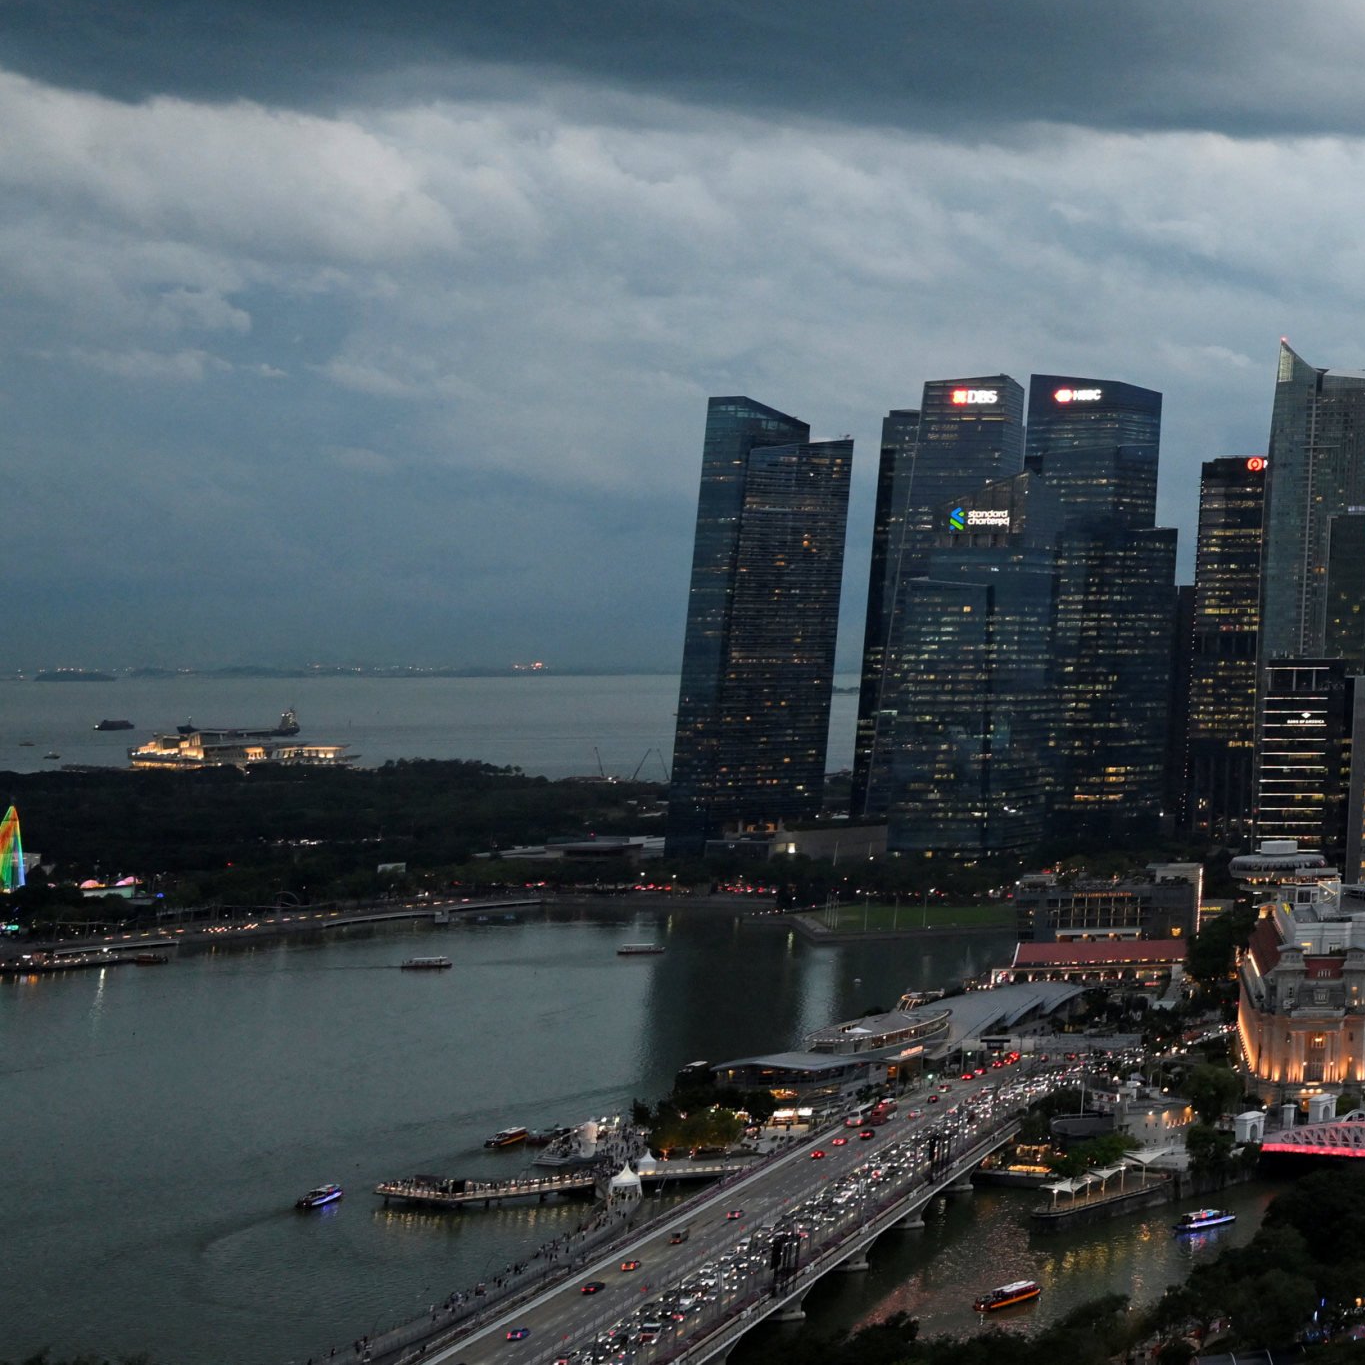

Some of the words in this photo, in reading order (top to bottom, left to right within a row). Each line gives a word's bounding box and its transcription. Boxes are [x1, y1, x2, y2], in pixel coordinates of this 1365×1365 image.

[967, 390, 998, 404] DBS
[1072, 389, 1102, 401] HSBC
[967, 517, 1010, 526] chartered
